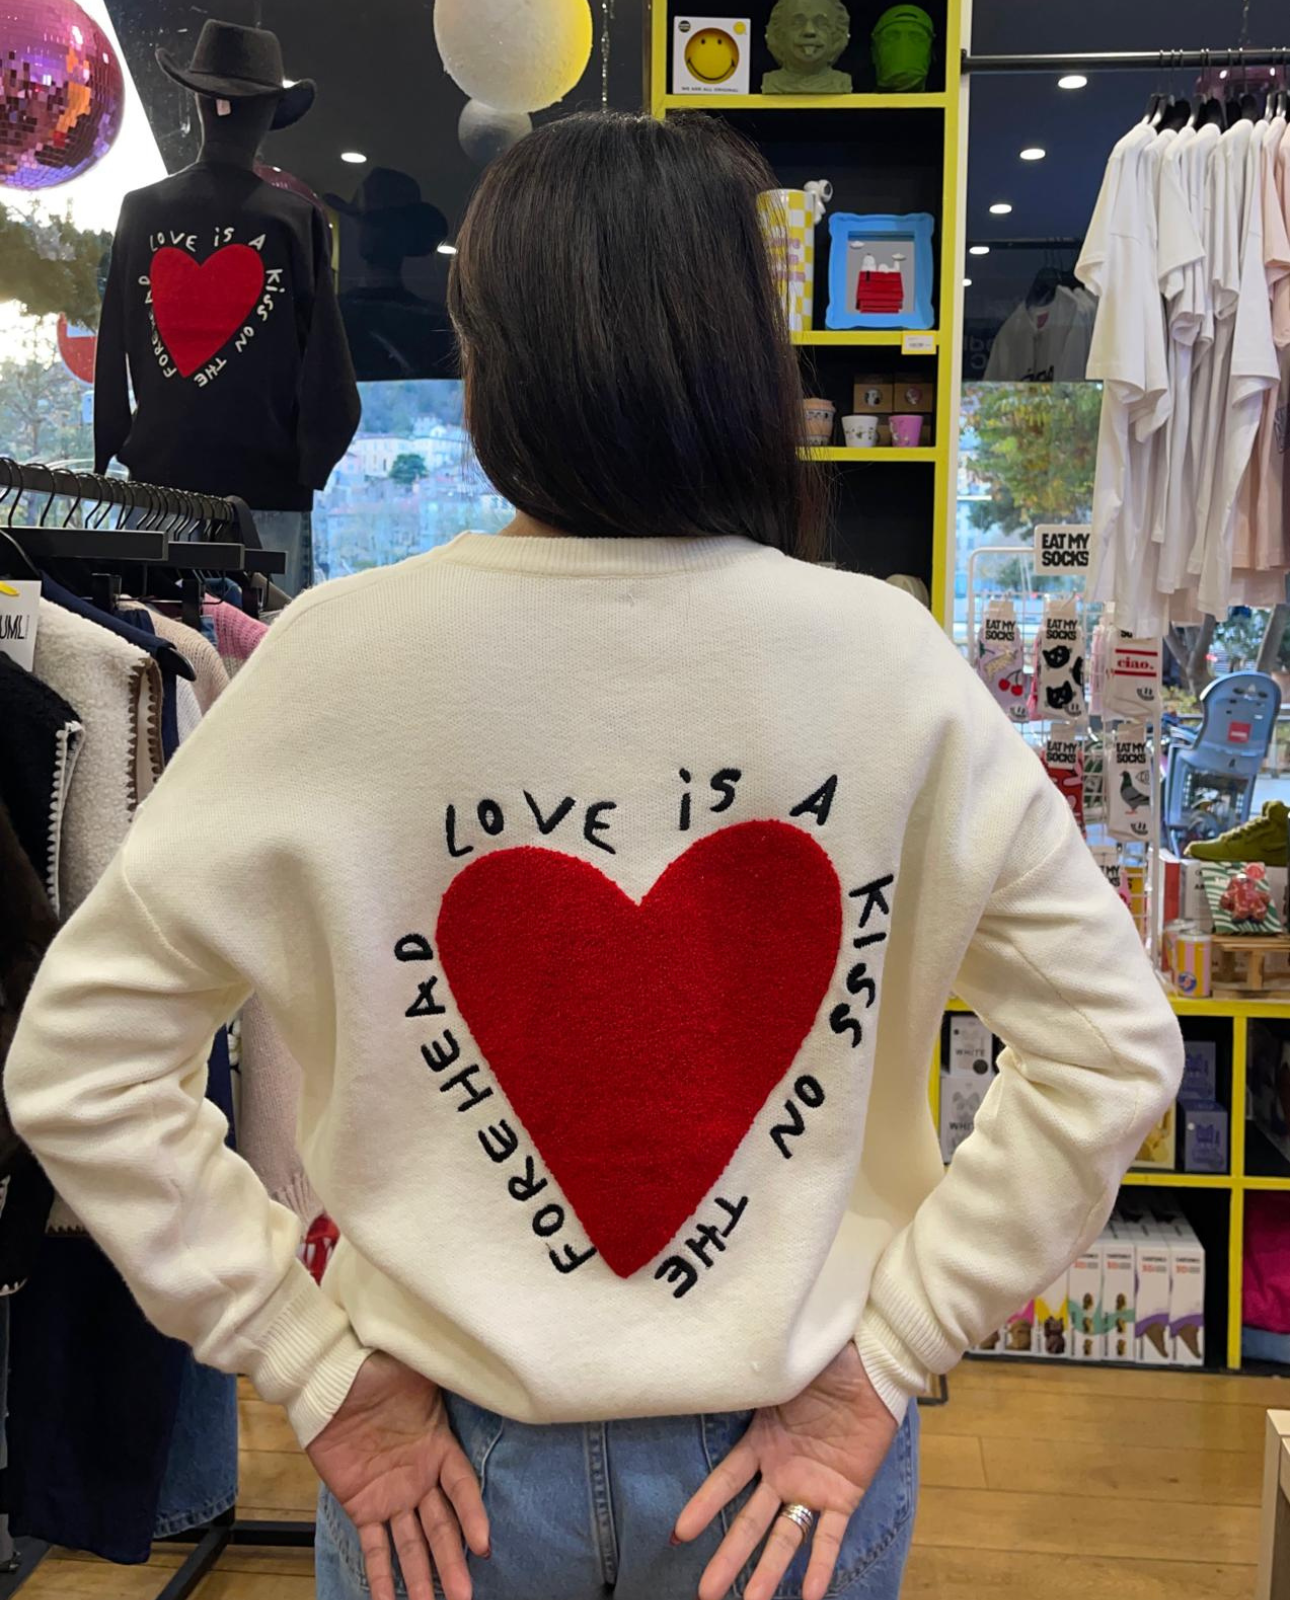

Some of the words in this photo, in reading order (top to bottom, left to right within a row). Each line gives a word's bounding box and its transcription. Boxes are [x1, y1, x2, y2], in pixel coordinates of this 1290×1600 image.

[150, 230, 198, 252] LOVE
[248, 234, 266, 252] A
[235, 326, 256, 354] ON
[193, 356, 228, 388] THE
[1042, 533, 1066, 549] EAT
[1068, 533, 1090, 549] MY
[1042, 550, 1089, 566] SOCKS
[986, 619, 1002, 630] EAT
[1002, 620, 1016, 631] MY
[1047, 618, 1063, 629] EAT
[1064, 619, 1078, 630] MY
[986, 630, 1014, 641] SOCKS
[1046, 630, 1076, 640] SOCKS
[1117, 656, 1154, 670] ciao.
[1047, 740, 1062, 752] EAT
[1063, 742, 1078, 752] MY
[1116, 742, 1132, 752] EAT
[1132, 742, 1146, 752] MY
[1047, 752, 1076, 763] SOCKS
[1117, 753, 1146, 764] SOCKS
[790, 774, 838, 826] A
[446, 790, 617, 856] LOVE
[830, 874, 894, 1048] KISS
[394, 933, 599, 1275] FOREHEAD
[770, 1075, 826, 1159] ON
[655, 1194, 749, 1298] THE
